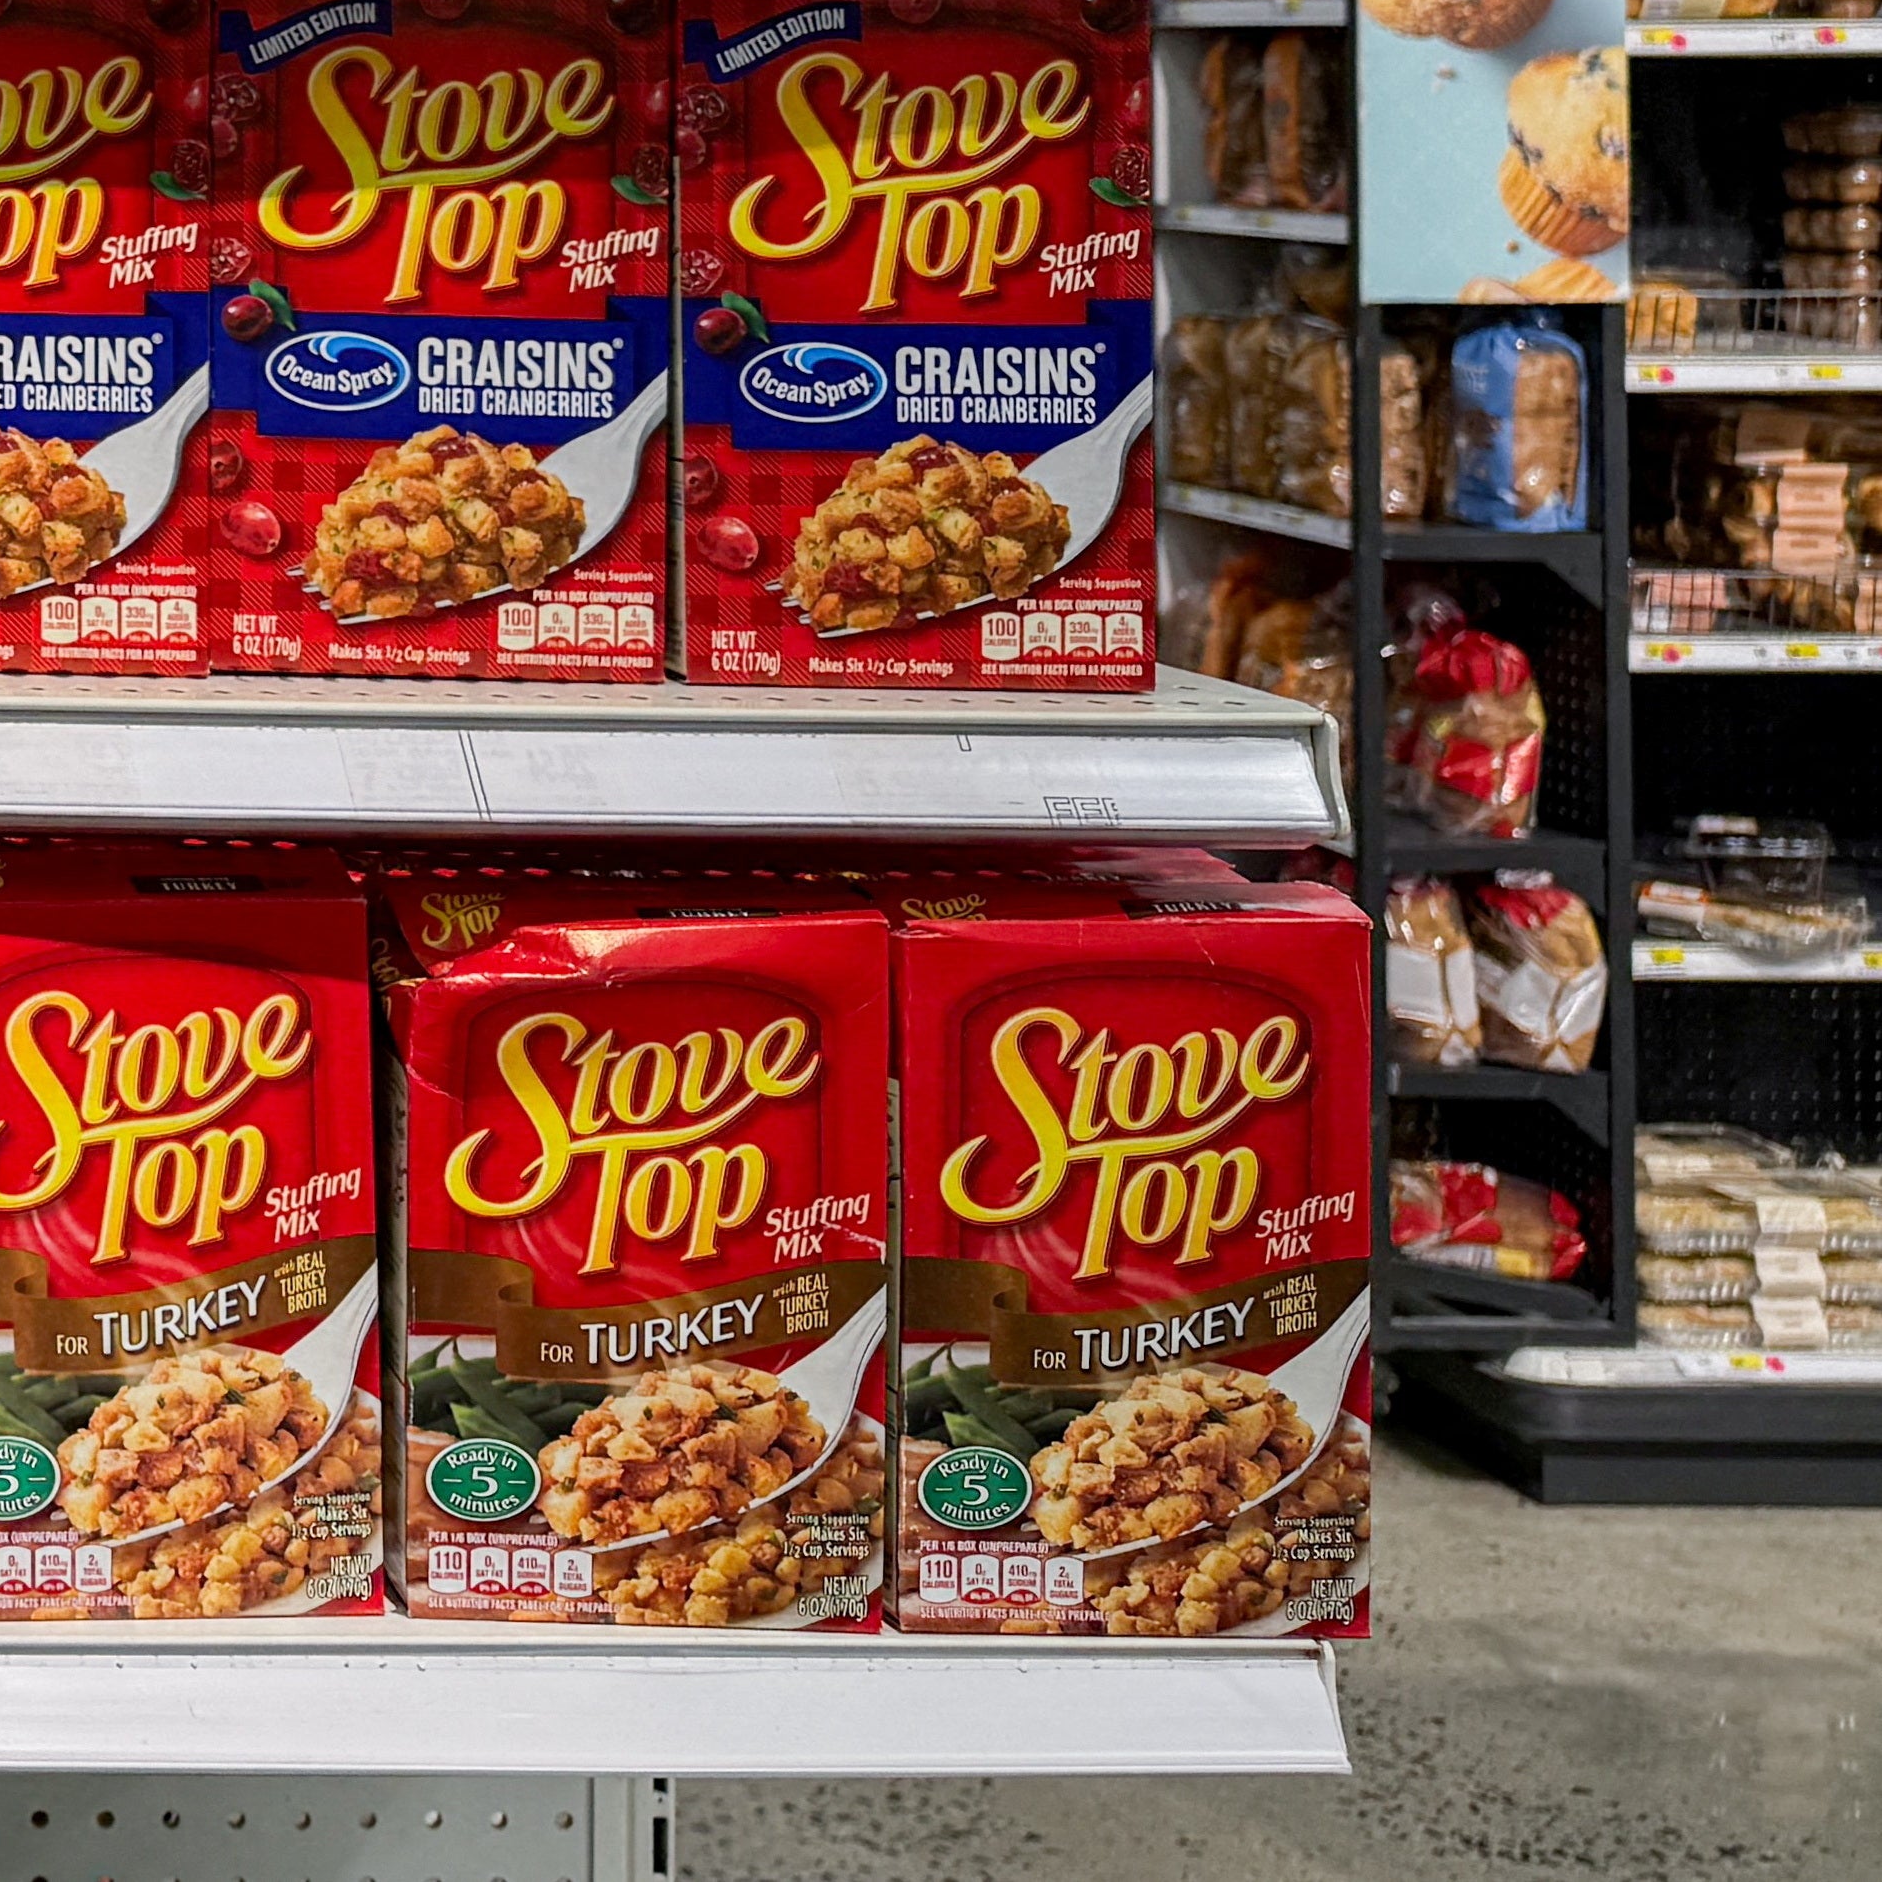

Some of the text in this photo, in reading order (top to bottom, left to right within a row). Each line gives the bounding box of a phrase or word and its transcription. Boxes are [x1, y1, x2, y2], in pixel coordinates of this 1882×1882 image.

[729, 53, 1090, 260] Stove
[852, 179, 1042, 316] Top
[895, 344, 1097, 397] CRAISINS
[941, 1007, 1309, 1225] Stove
[1061, 1142, 1259, 1283] Top
[1255, 1191, 1355, 1238] Stuffing
[1265, 1231, 1313, 1265] Mix
[93, 1273, 267, 1357] TURKEY
[1270, 1292, 1317, 1319] TURKEY
[1287, 1273, 1316, 1294] REAL
[579, 1291, 763, 1367] TURKEY
[1074, 1295, 1255, 1372] TURKEY
[1276, 1312, 1317, 1335] BROTH
